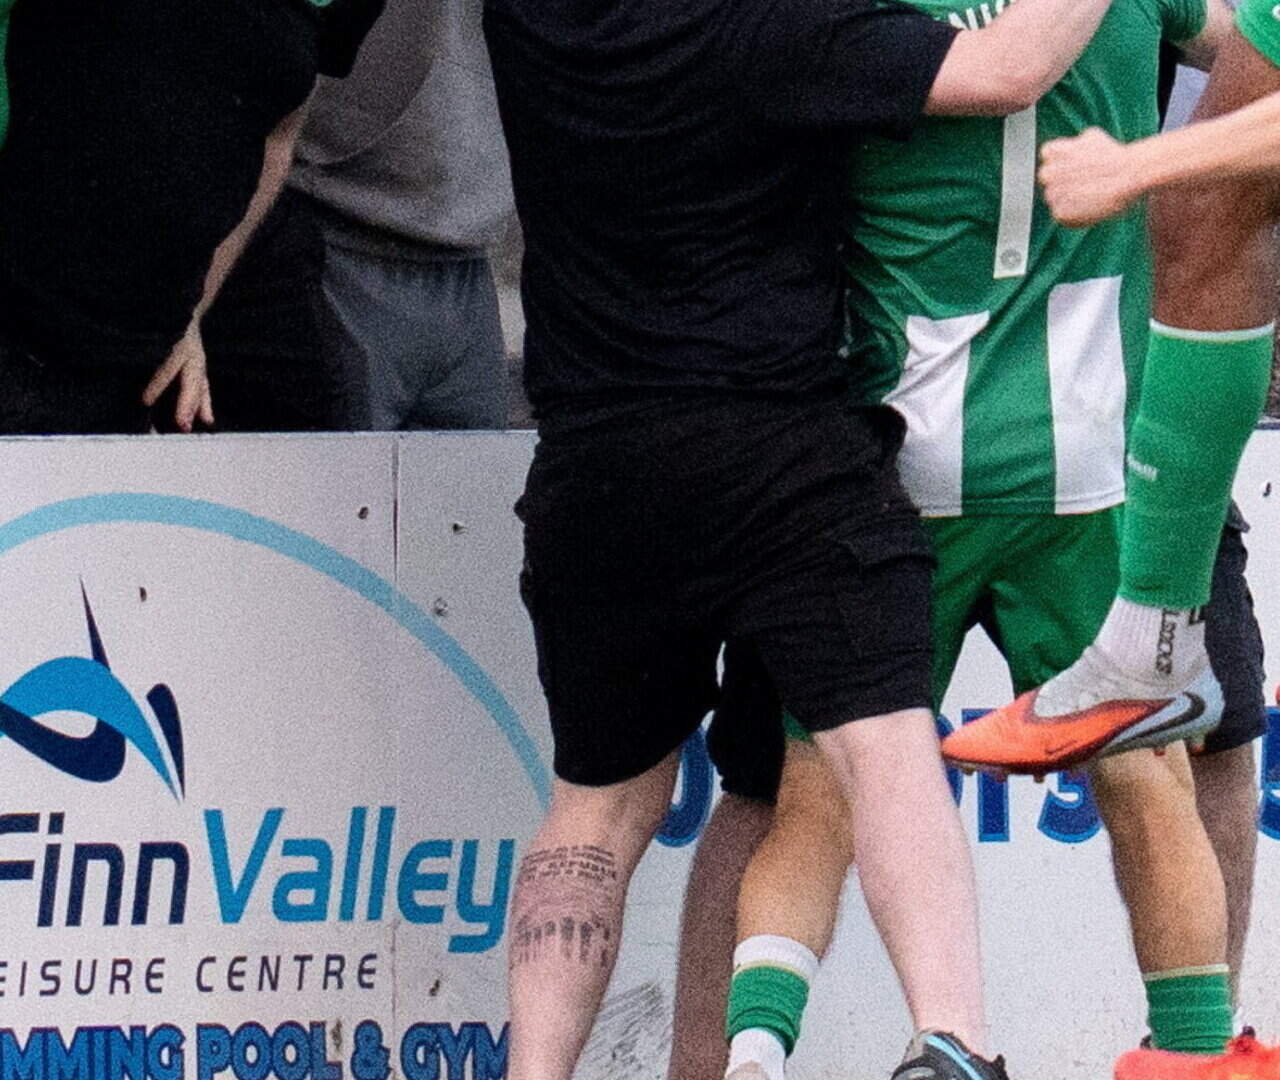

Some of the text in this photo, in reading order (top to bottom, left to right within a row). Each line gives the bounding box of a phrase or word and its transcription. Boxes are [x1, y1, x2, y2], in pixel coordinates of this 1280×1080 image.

[196, 953, 379, 992] CENTRE
[197, 1021, 342, 1080] POOL
[351, 1019, 393, 1080] &
[400, 1021, 510, 1080] GYM
